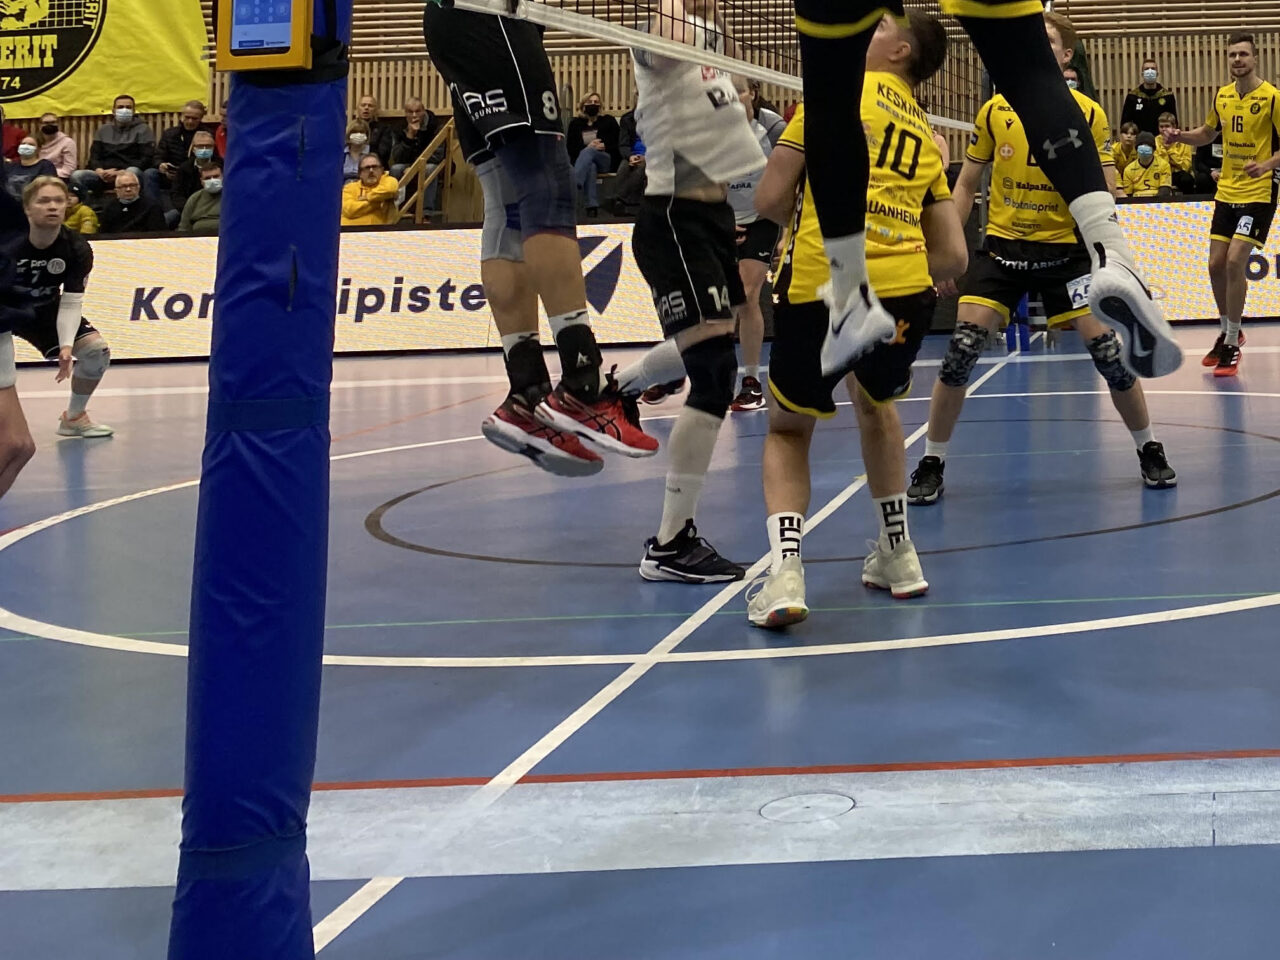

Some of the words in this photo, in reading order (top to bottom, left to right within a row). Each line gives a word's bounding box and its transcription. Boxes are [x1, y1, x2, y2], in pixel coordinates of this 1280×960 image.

[0, 34, 58, 69] ERIT
[542, 90, 558, 120] 8
[877, 82, 933, 133] KESKINE
[1231, 114, 1243, 133] 16
[876, 121, 922, 181] 10
[1015, 181, 1056, 192] HalpaHa
[129, 275, 489, 324] Konipiste
[707, 284, 732, 312] 14
